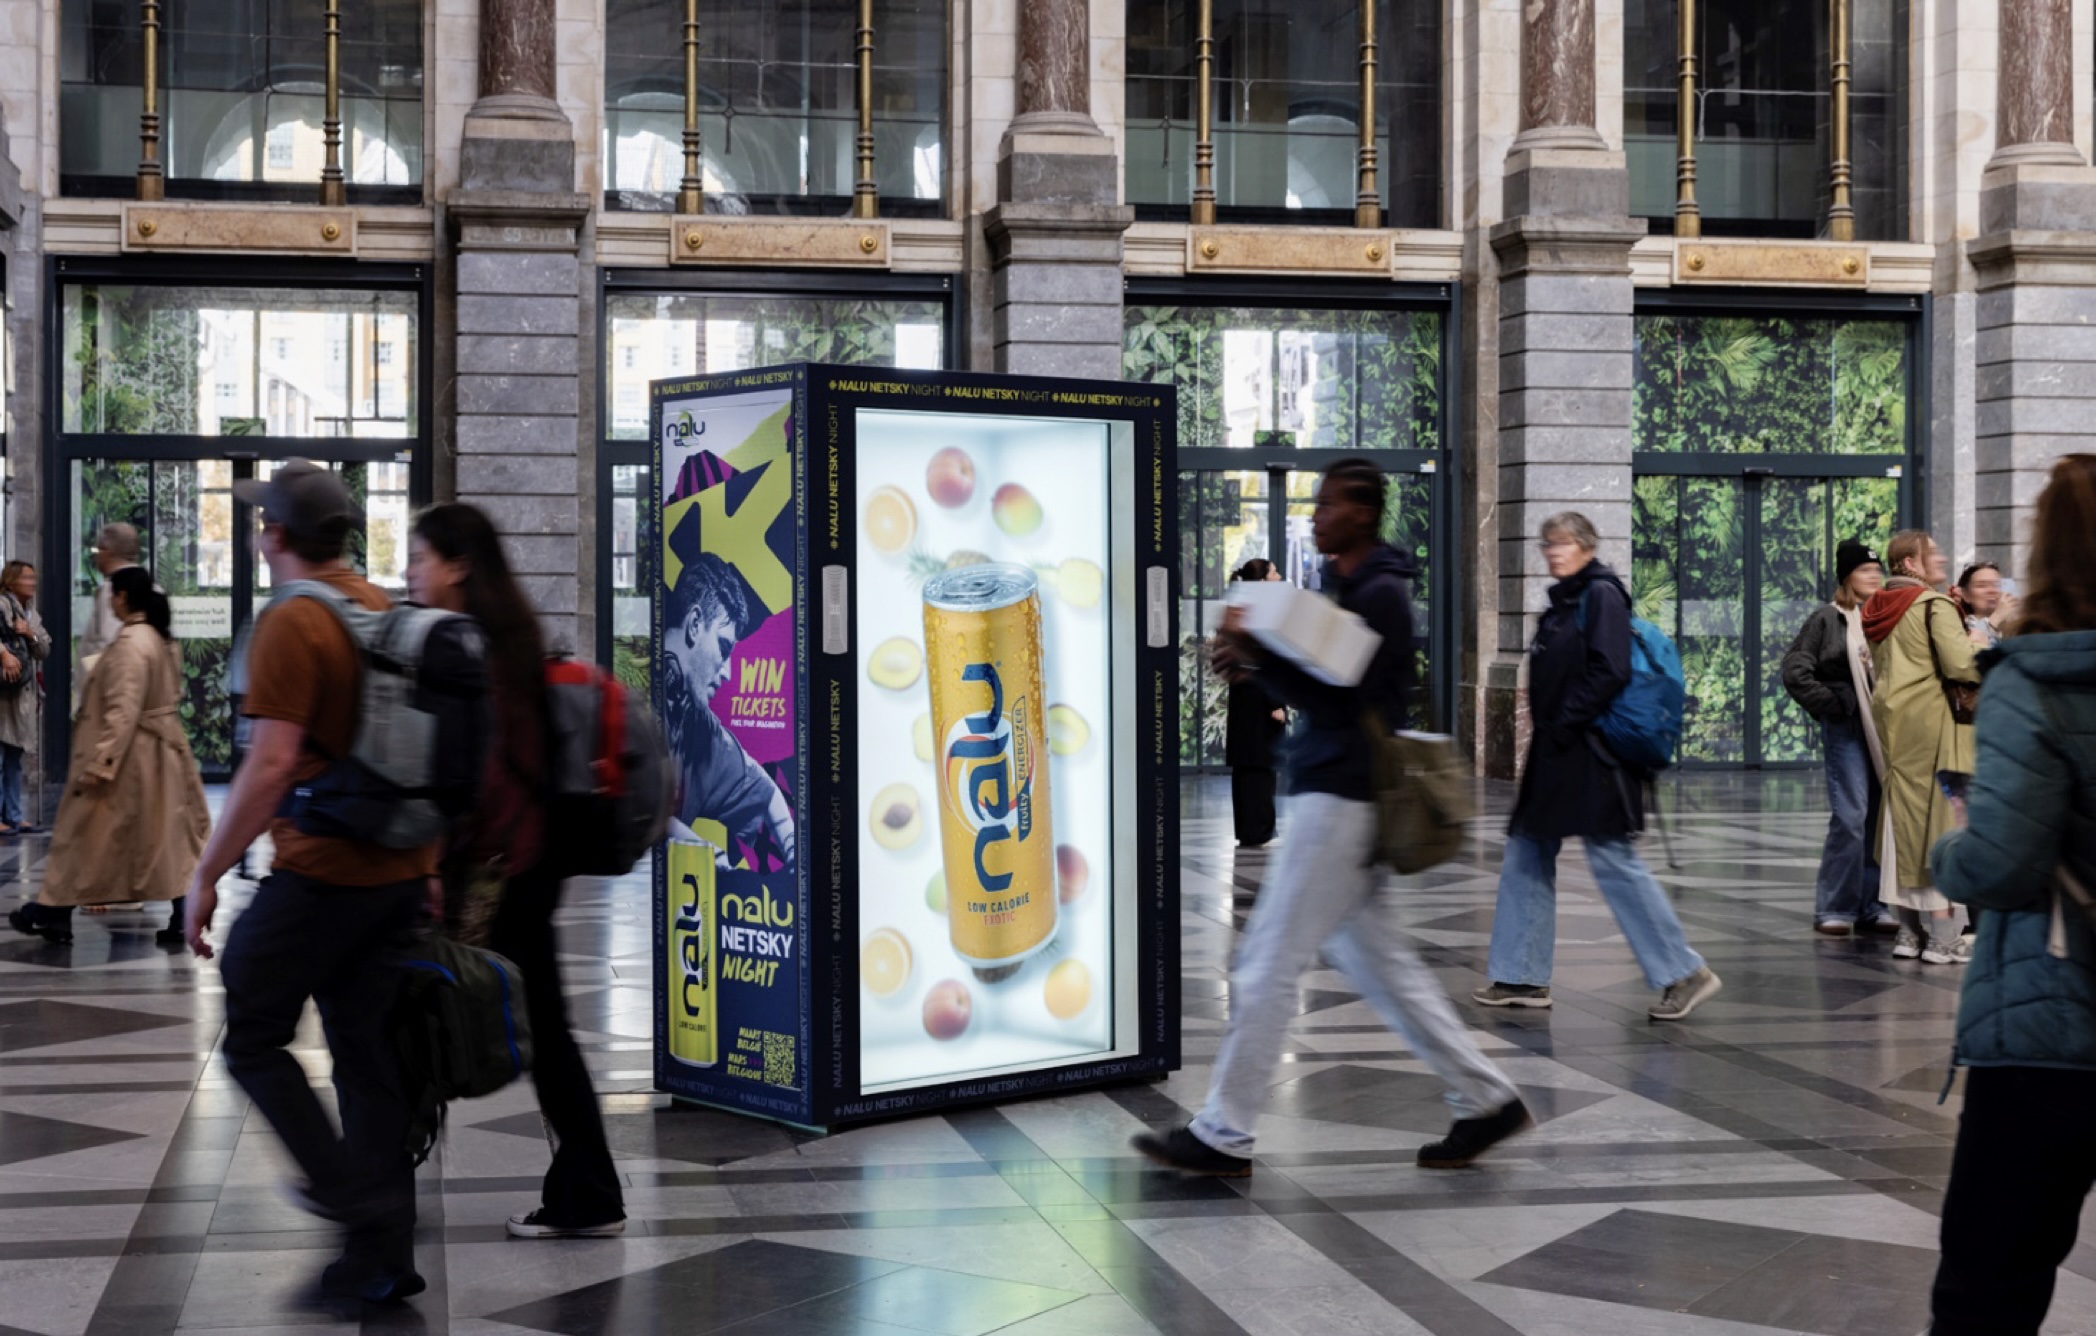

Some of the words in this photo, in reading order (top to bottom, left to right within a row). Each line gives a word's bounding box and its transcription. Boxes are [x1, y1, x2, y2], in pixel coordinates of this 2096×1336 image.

[662, 384, 682, 394] NALU
[682, 380, 709, 393] NETSKY
[711, 377, 733, 390] NIGHT
[741, 376, 763, 386] NALU
[764, 372, 794, 383] NETSKY
[838, 380, 868, 392] NALU
[870, 382, 910, 394] NETSKY
[911, 384, 941, 397] NIGHT
[953, 386, 981, 399] NALU
[982, 387, 1021, 401] NETSKY
[1021, 391, 1050, 403] NIGHT
[1060, 392, 1086, 404] NALU
[1087, 394, 1124, 406] NETSKY
[1124, 396, 1152, 407] NIGHT
[666, 412, 705, 438] nalu
[796, 387, 804, 427] NIGHT
[828, 403, 838, 444] NIGHT
[796, 427, 805, 478] NETSKY
[1153, 419, 1161, 456] NIGHT
[828, 445, 839, 497] NETSKY
[1153, 457, 1162, 505] NETSKY
[796, 481, 805, 516] NALU
[828, 499, 839, 538] NALU
[1153, 507, 1162, 542] NALU
[797, 535, 805, 573] NIGHT
[797, 575, 805, 625] NETSKY
[797, 628, 805, 663] NALU
[740, 657, 786, 694] WIN
[1155, 670, 1163, 718] NETSKY
[731, 697, 786, 718] TICKETS
[798, 680, 806, 719] NIGHT
[830, 679, 840, 731] NETSKY
[831, 733, 841, 771] NALU
[1015, 708, 1026, 781] ENERGIZER
[1155, 720, 1164, 755] NALU
[799, 773, 807, 810] NALU
[949, 663, 1013, 892] nalu
[1155, 776, 1164, 813] NIGHT
[831, 795, 841, 835] NIGHT
[1020, 794, 1029, 830] fruity
[799, 828, 807, 866] NIGHT
[1156, 814, 1164, 862] NETSKY
[832, 838, 841, 890] NETSKY
[1156, 864, 1164, 899] NALU
[722, 884, 793, 927] nalu
[832, 892, 842, 930] NALU
[968, 901, 986, 913] LOW
[991, 892, 1030, 913] CALORIE
[984, 912, 1015, 926] EXOTIC
[674, 873, 700, 1017] nalu
[722, 925, 793, 958] NETSKY
[800, 920, 808, 957] NALU
[1156, 920, 1165, 956] NIGHT
[722, 953, 779, 988] NIGHT
[832, 953, 842, 995] NIGHT
[1157, 959, 1165, 1006] NETSKY
[800, 976, 808, 1014] NIGHT
[800, 1015, 808, 1065] NETSKY
[833, 996, 842, 1048] NETSKY
[1157, 1008, 1165, 1042] NALU
[728, 1063, 762, 1081] BELGIQUE
[833, 1050, 842, 1088] NALU
[844, 1101, 874, 1115] NALU
[876, 1095, 915, 1110] NETSKY
[916, 1090, 947, 1105] NIGHT
[958, 1084, 986, 1098] NALU
[987, 1079, 1026, 1093] NETSKY
[1026, 1073, 1053, 1087] NIGHT
[1064, 1070, 1091, 1082] NALU
[1093, 1063, 1129, 1077] NETSKY
[1129, 1058, 1156, 1071] NIGHT
[665, 1077, 685, 1089] NALU
[687, 1080, 715, 1095] NETSKY
[743, 1093, 767, 1107] NALU
[768, 1097, 800, 1115] NETSKY
